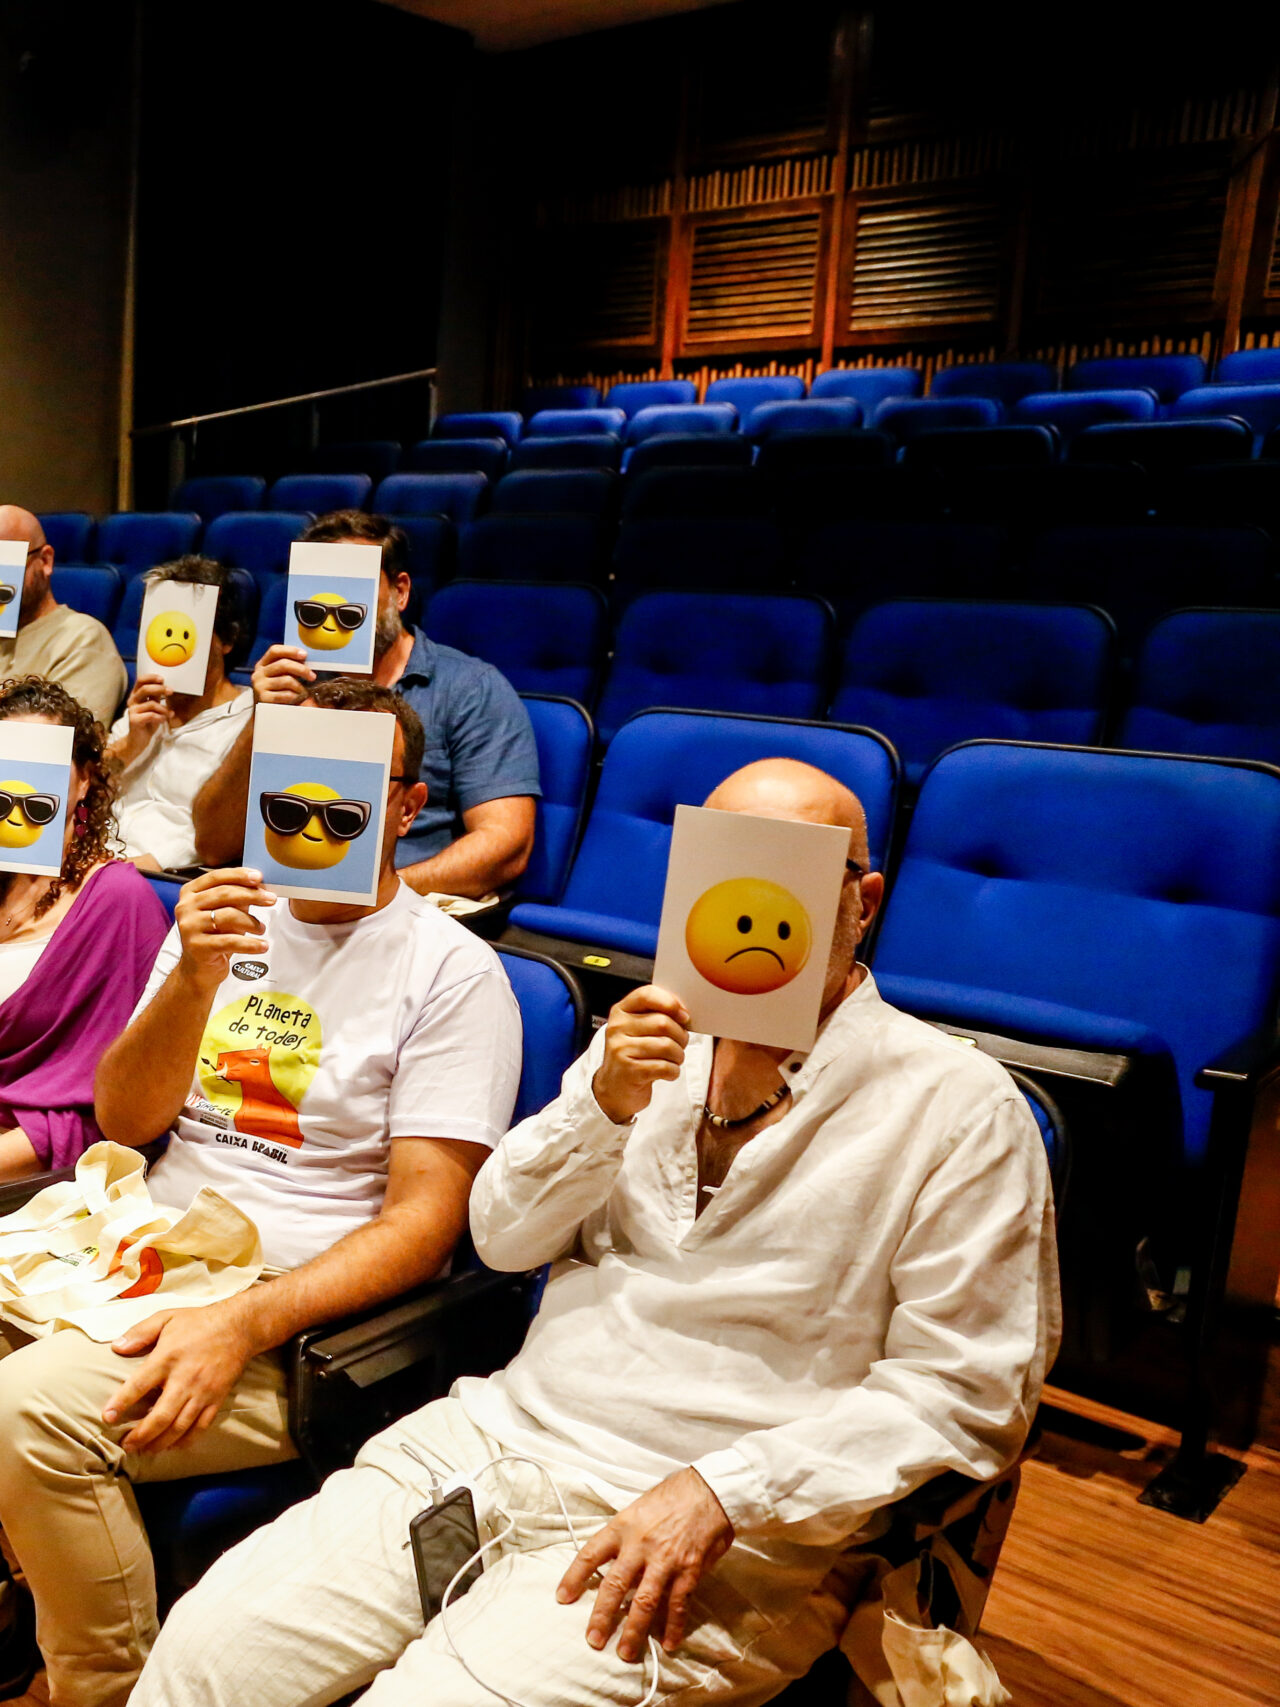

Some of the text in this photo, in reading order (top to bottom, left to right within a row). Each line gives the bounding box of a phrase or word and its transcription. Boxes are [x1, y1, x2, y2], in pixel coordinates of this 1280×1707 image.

[233, 964, 261, 979] CULTURAL
[244, 963, 265, 974] CAIXA
[229, 1016, 249, 1034] de
[215, 1133, 248, 1149] CAIXA
[252, 1141, 288, 1164] BRASIL
